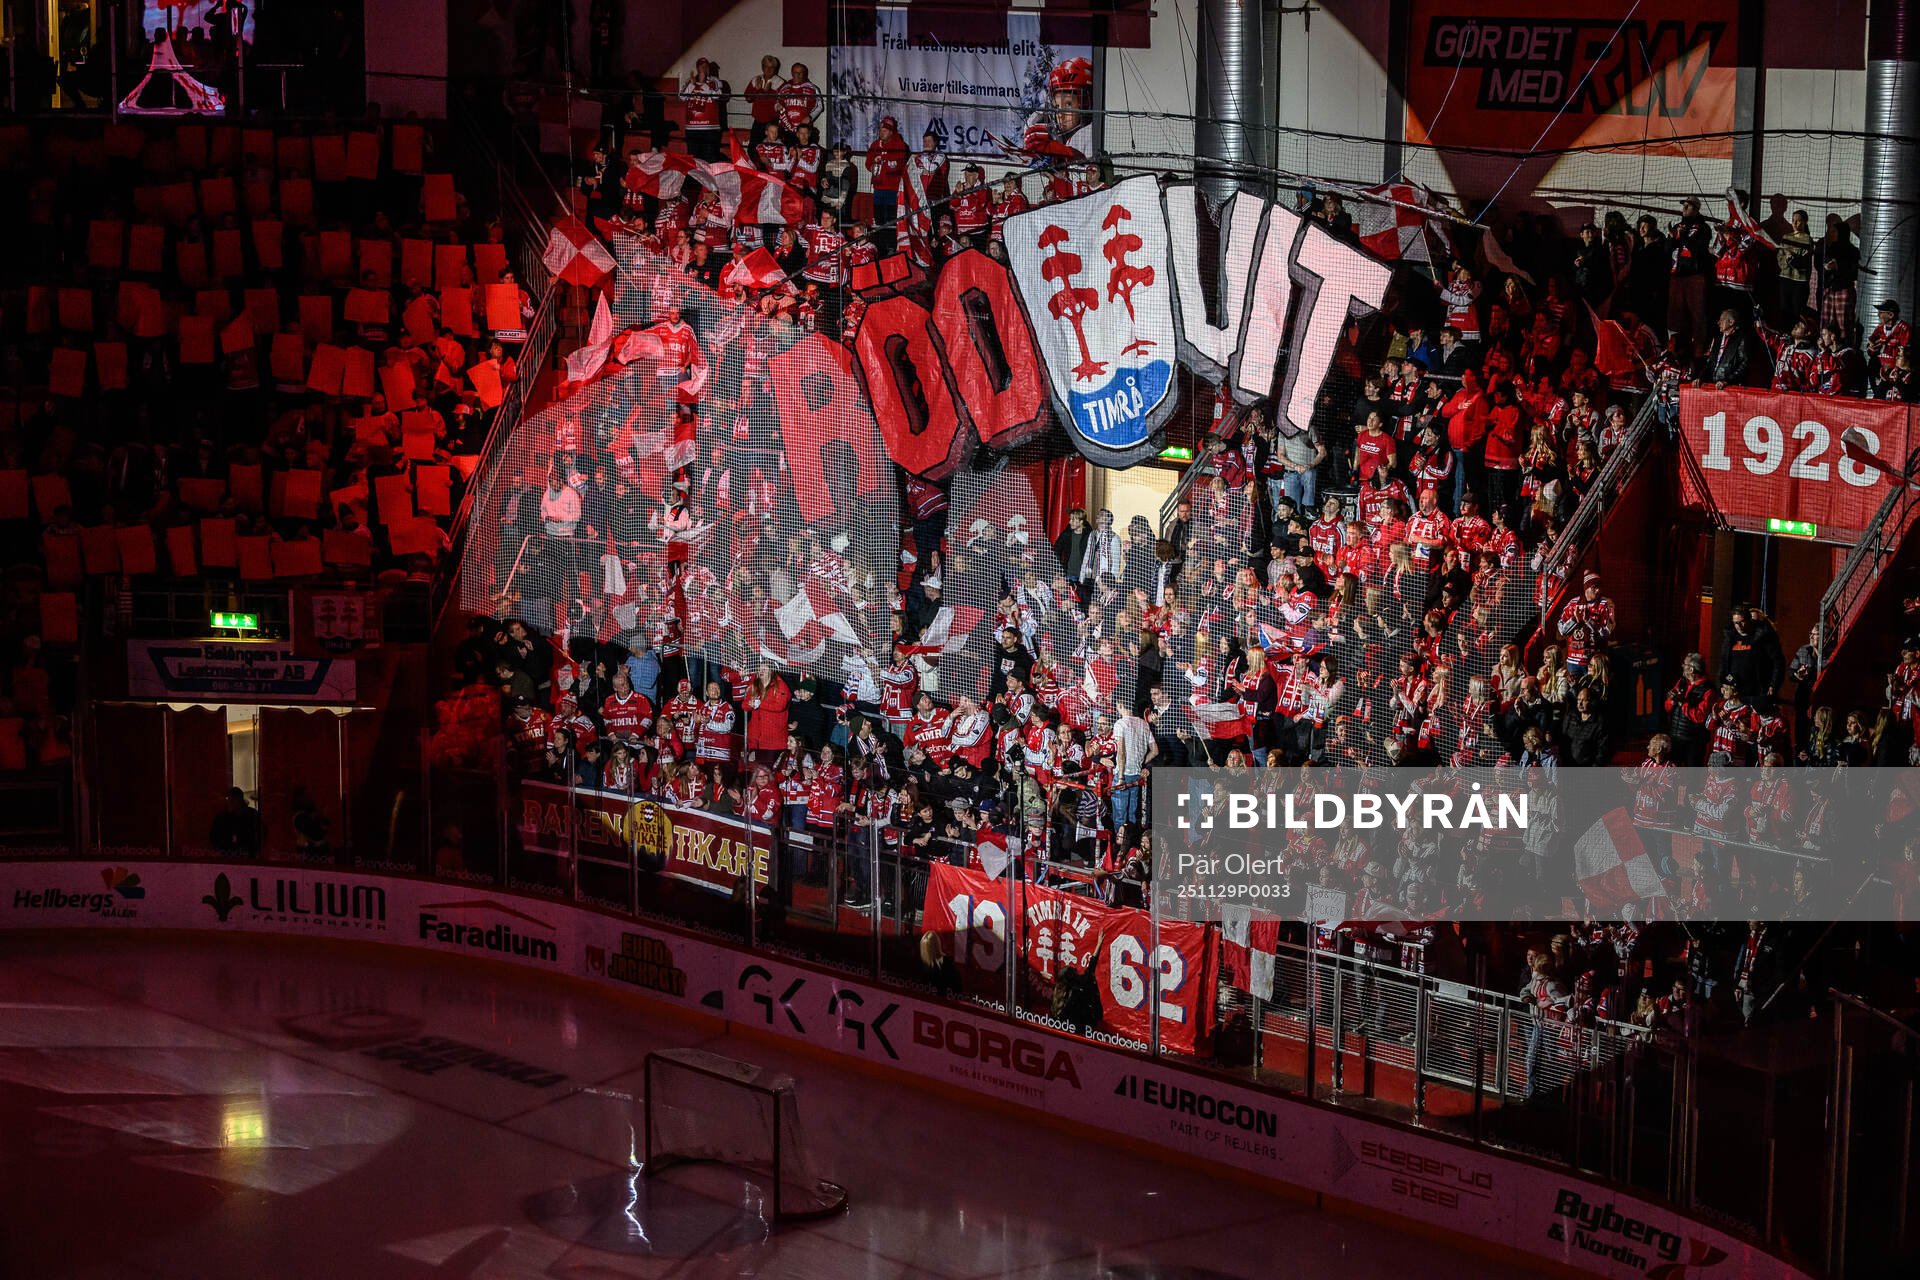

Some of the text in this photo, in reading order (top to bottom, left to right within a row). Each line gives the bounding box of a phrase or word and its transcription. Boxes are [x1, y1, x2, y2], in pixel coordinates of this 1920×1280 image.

[882, 32, 912, 51] Från
[992, 38, 1010, 56] till
[1013, 39, 1037, 57] elit
[1434, 19, 1572, 61] GÖR DET
[898, 77, 1021, 98] Vi växer tillsammans
[1487, 69, 1564, 105] MED
[953, 125, 994, 147] SCA
[1165, 185, 1394, 440] VIT
[1081, 376, 1146, 435] TIMRÅ
[1701, 411, 1881, 487] 1928
[673, 825, 770, 885] TIKARE
[13, 888, 114, 913] Hellbergs
[1026, 898, 1073, 927] TIMRÅ
[418, 912, 558, 962] Faradium
[948, 893, 1008, 972] 19
[1109, 933, 1188, 1024] 62
[1015, 1004, 1077, 1035] Brandcode
[1084, 1024, 1149, 1053] Brandcode
[912, 1009, 1083, 1090] BORGA
[1143, 1078, 1278, 1138] EUROCON
[1361, 1139, 1493, 1191] stegerud
[1391, 1176, 1459, 1211] steel
[1546, 1222, 1648, 1271] & Nordin
[1553, 1187, 1683, 1263] Byberg
